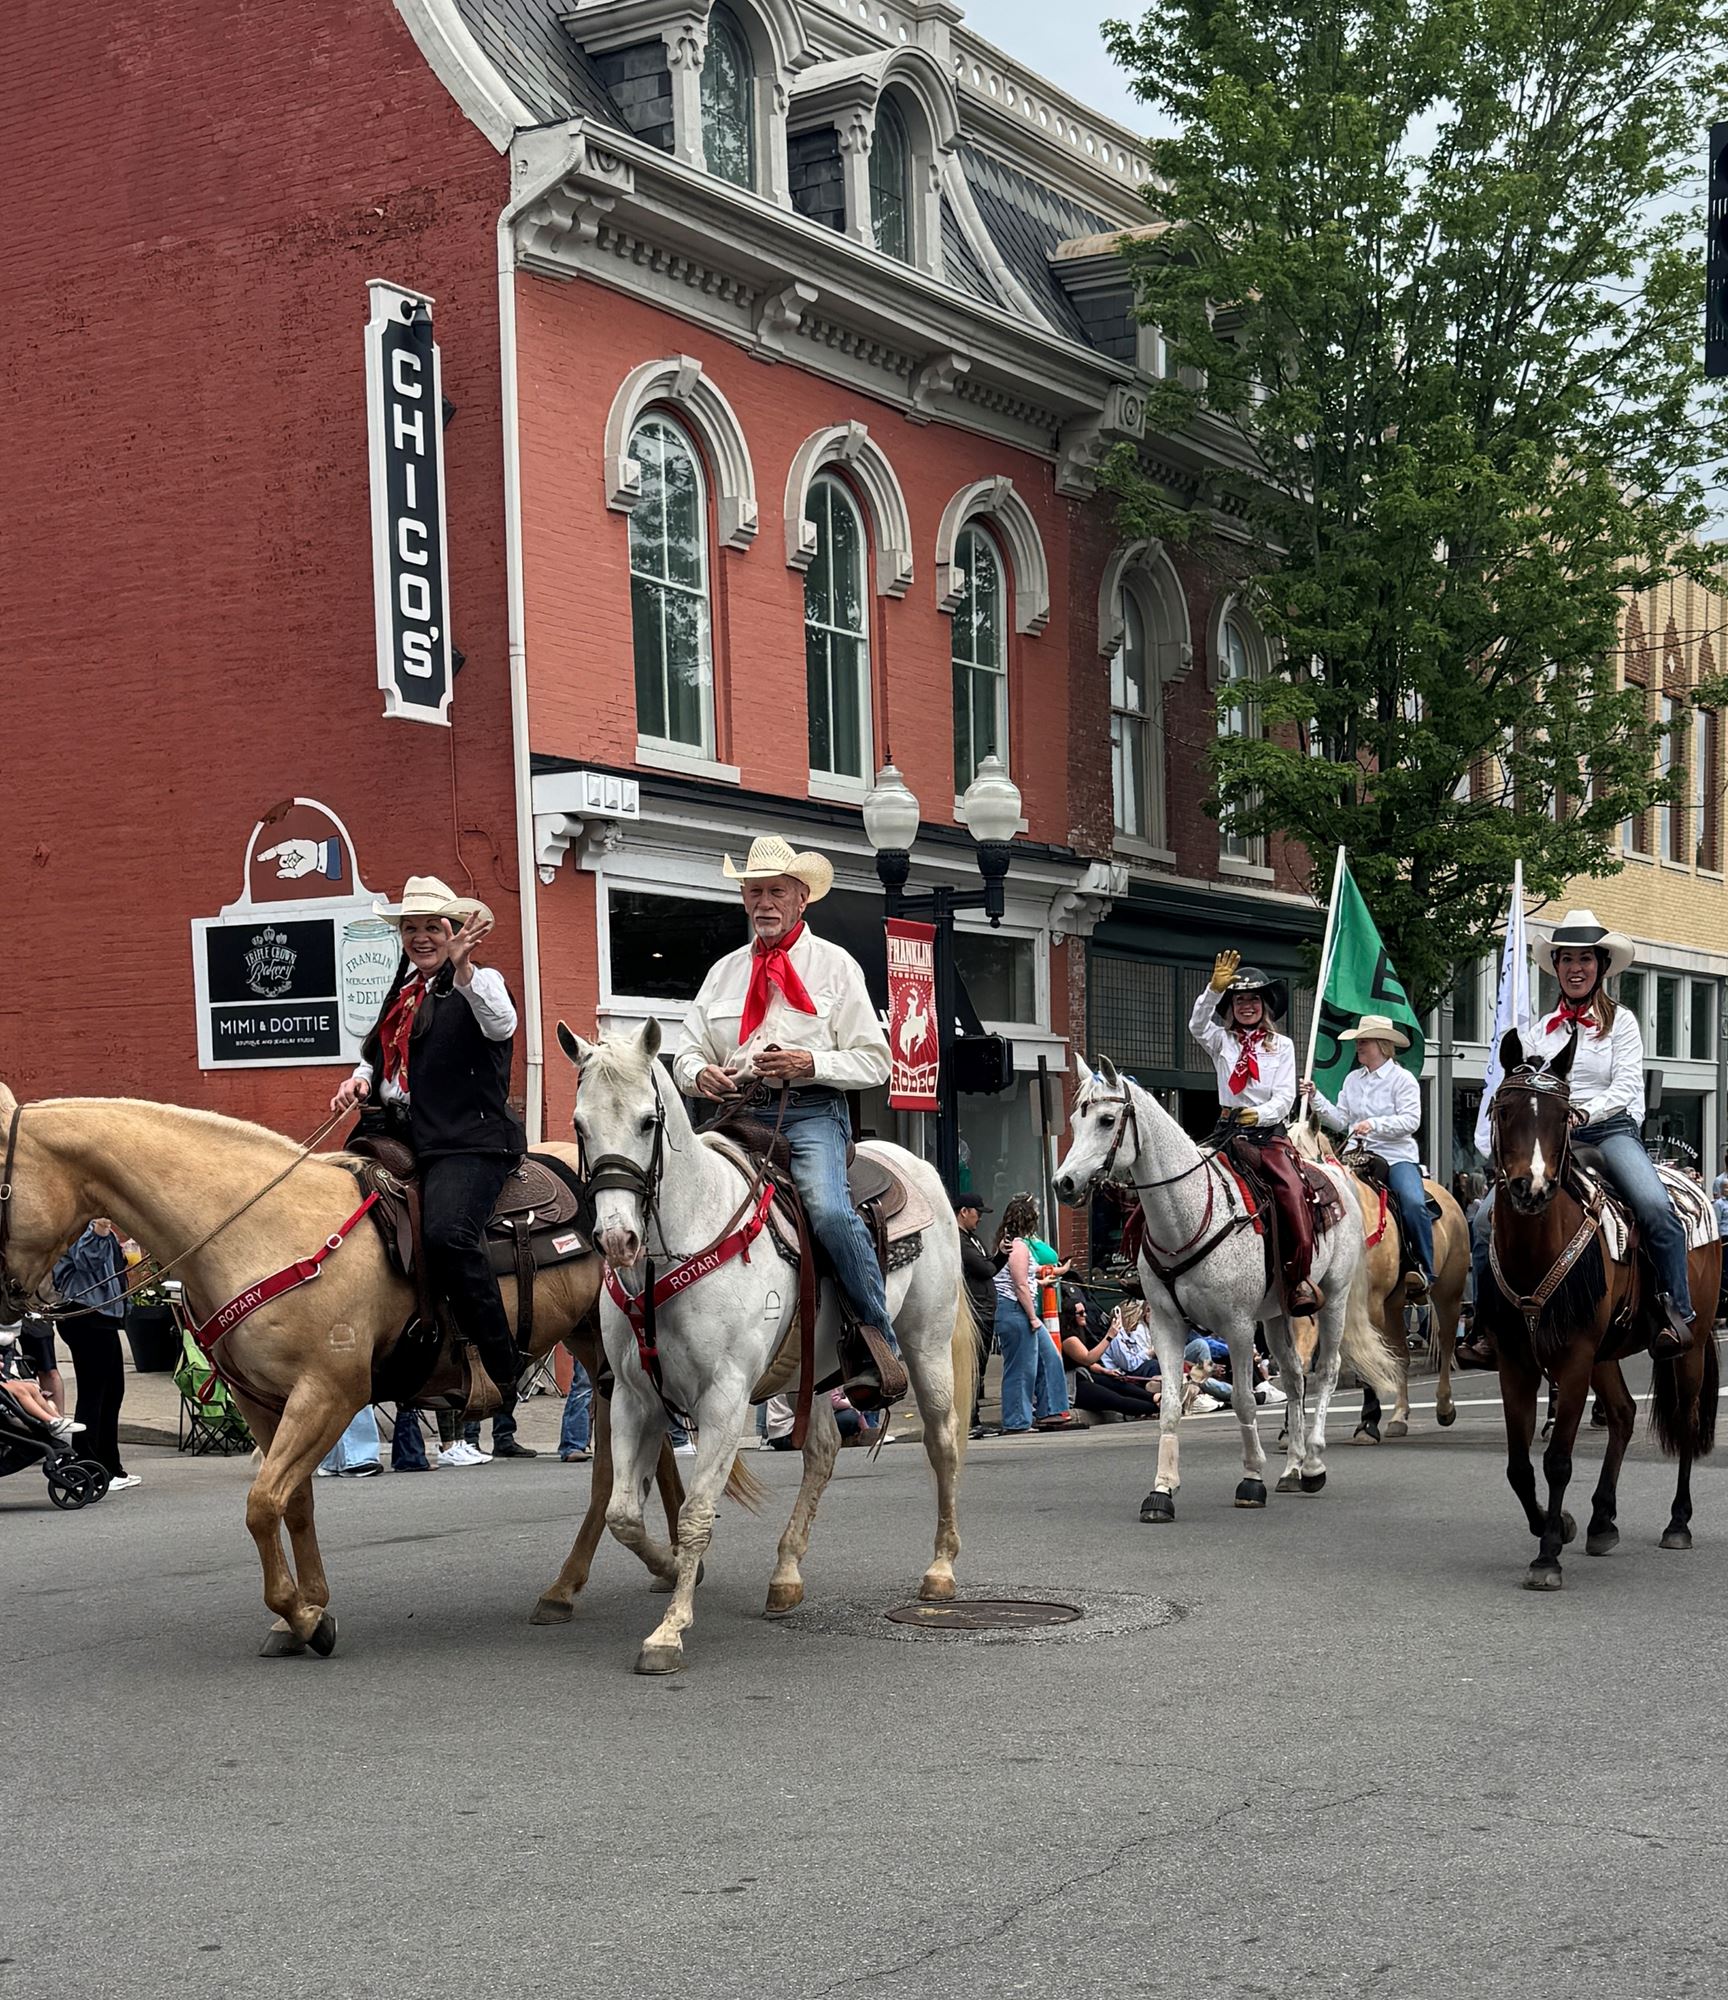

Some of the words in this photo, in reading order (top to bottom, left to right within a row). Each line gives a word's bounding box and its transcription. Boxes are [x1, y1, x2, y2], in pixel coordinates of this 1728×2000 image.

[391, 347, 439, 679] CHICO'S
[345, 952, 393, 973] FRANKLIN
[888, 938, 933, 968] FRANKLIN
[246, 959, 296, 983] Bakery
[345, 975, 392, 986] MERCANTILE
[356, 990, 384, 1005] DELI
[220, 1018, 255, 1035] MIMI
[259, 1020, 267, 1032] &
[270, 1015, 330, 1033] DOTTIE
[890, 1062, 937, 1093] RODEO
[1667, 1136, 1699, 1160] HANDS
[670, 1250, 721, 1290] ROTARY
[217, 1287, 263, 1327] ROTARY
